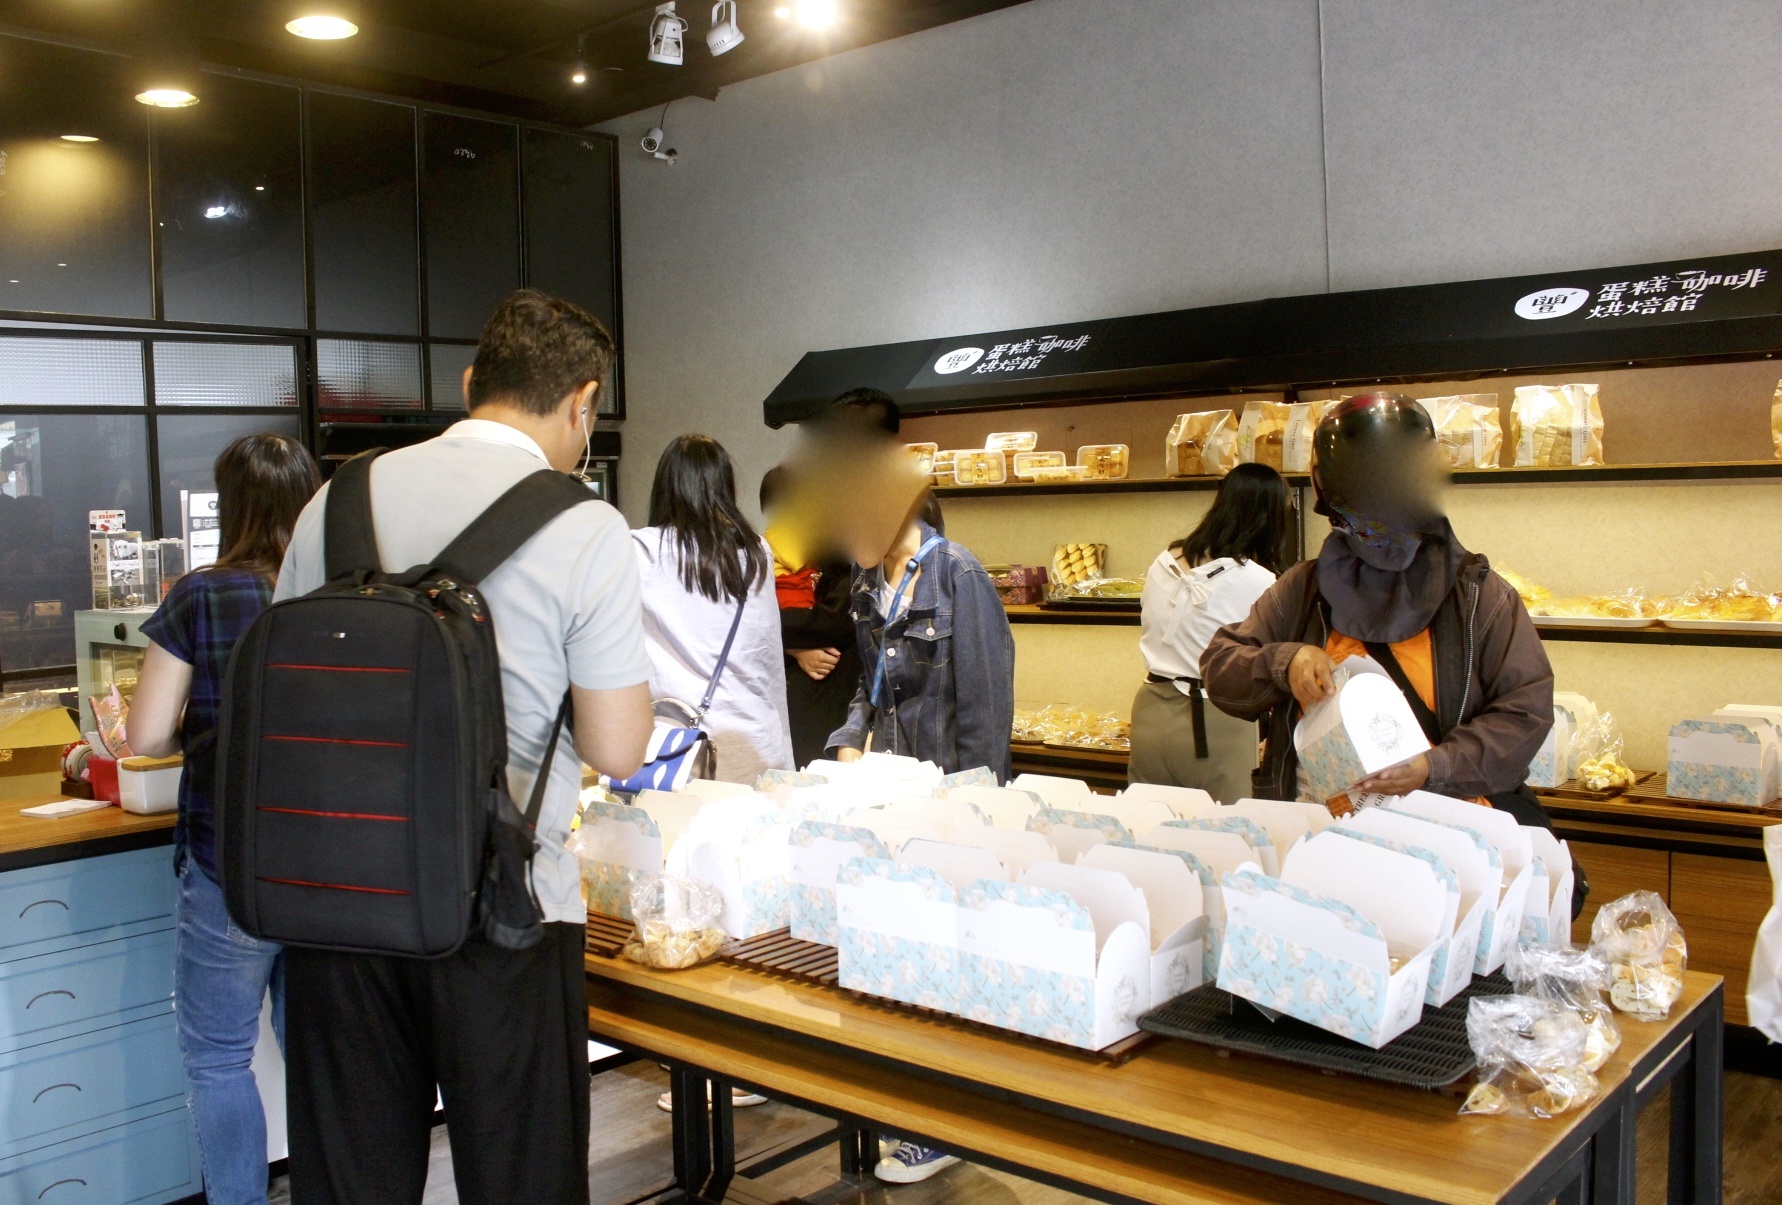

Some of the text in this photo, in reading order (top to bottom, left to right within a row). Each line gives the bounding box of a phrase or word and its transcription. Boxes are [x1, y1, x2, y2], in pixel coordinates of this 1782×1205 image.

[1597, 269, 1768, 303] 蛋糕咖啡
[1585, 293, 1704, 320] 烘焙館
[985, 335, 1092, 361] 蛋糕咖啡
[971, 354, 1047, 376] 烘焙館
